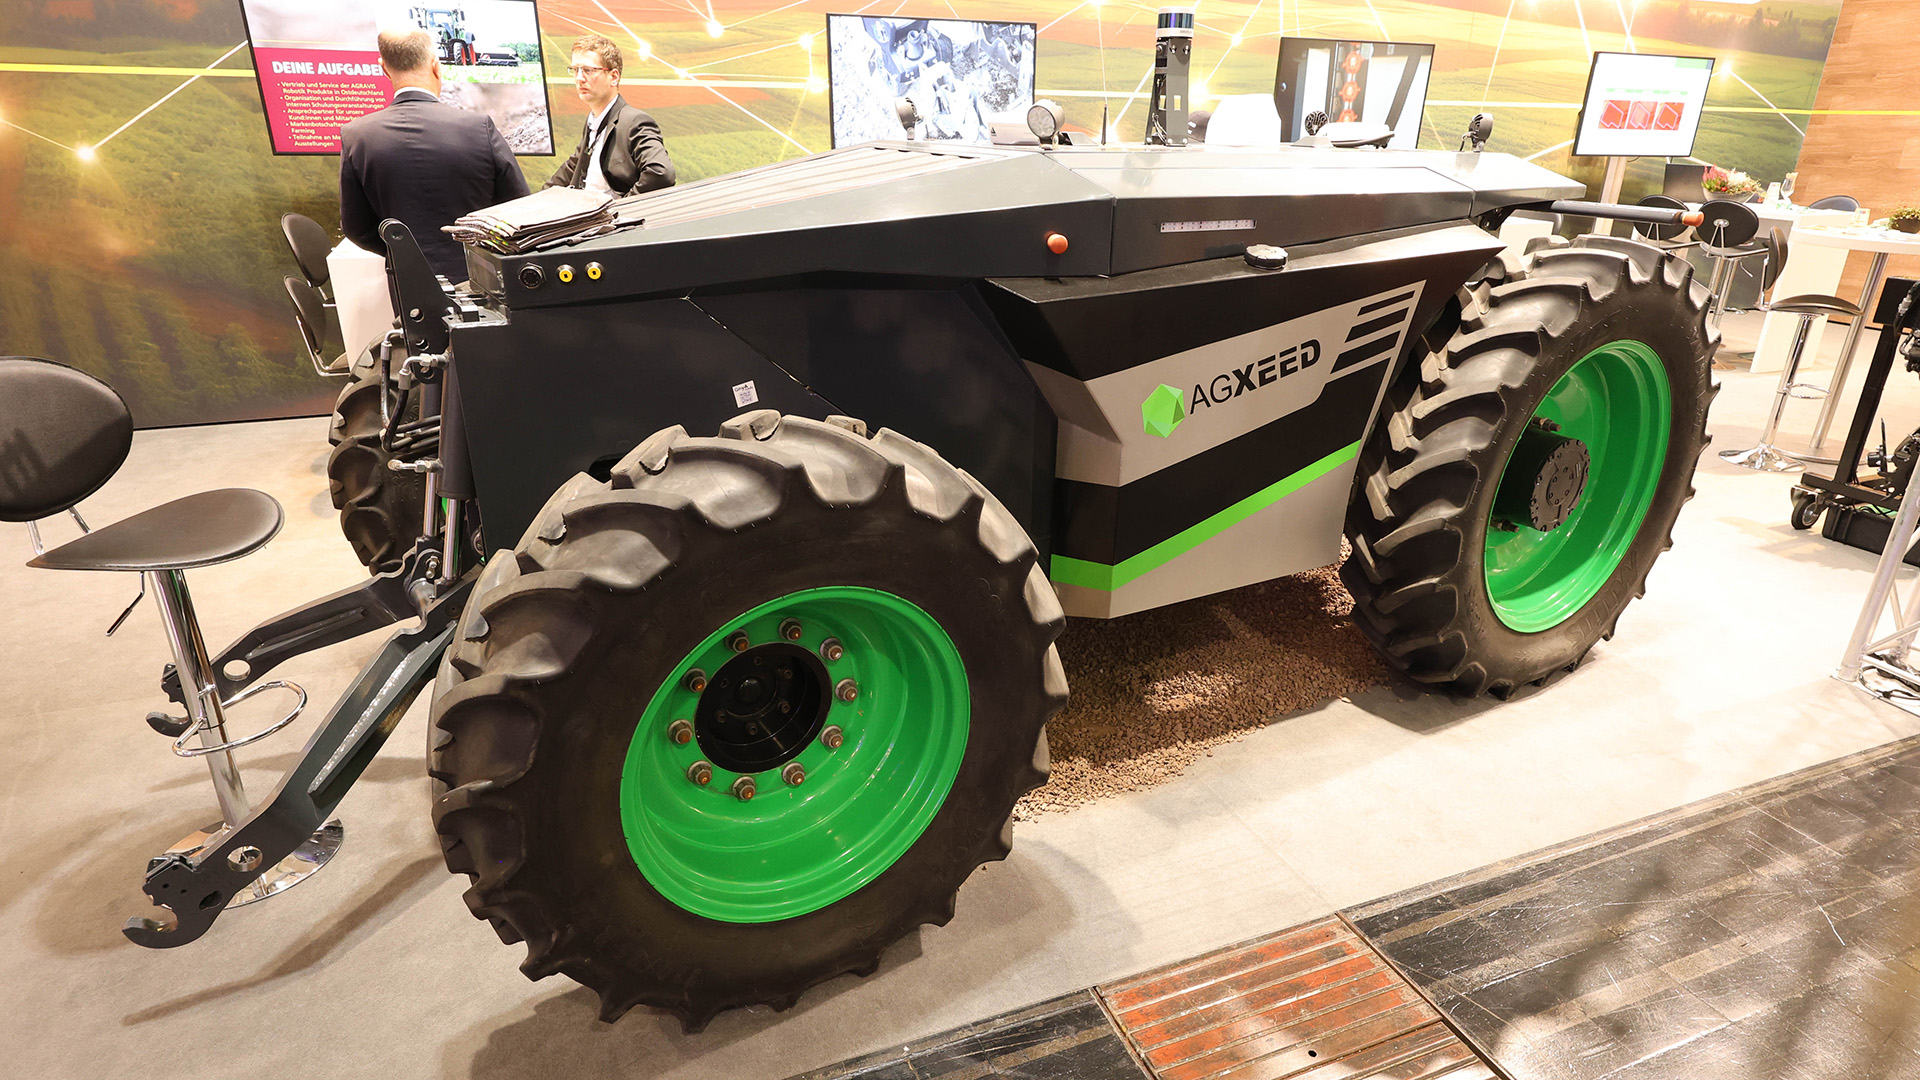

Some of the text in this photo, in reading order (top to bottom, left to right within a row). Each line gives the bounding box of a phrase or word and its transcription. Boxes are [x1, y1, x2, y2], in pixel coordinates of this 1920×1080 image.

[272, 61, 315, 74] DEINE
[335, 95, 375, 103] Durchführung
[311, 102, 385, 110] Schulungsveranstaltungen
[1190, 339, 1321, 415] AGXEED
